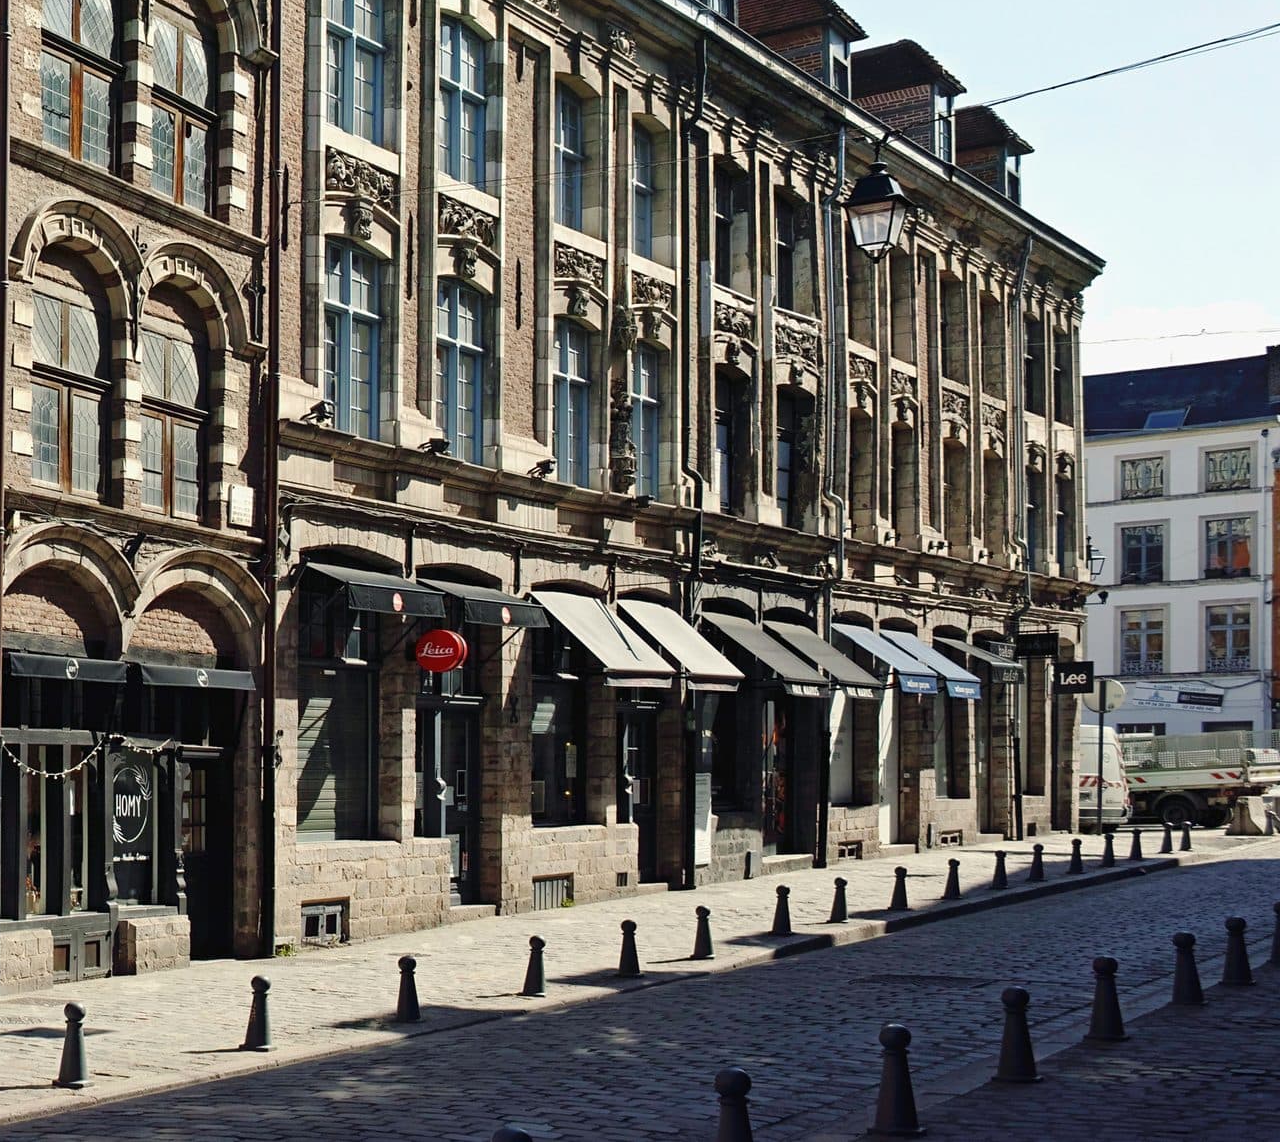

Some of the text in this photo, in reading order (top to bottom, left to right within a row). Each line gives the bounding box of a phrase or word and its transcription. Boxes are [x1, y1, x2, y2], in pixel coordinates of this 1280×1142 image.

[419, 642, 454, 657] Leica
[1060, 673, 1087, 685] Lee
[115, 794, 141, 817] HOMY
